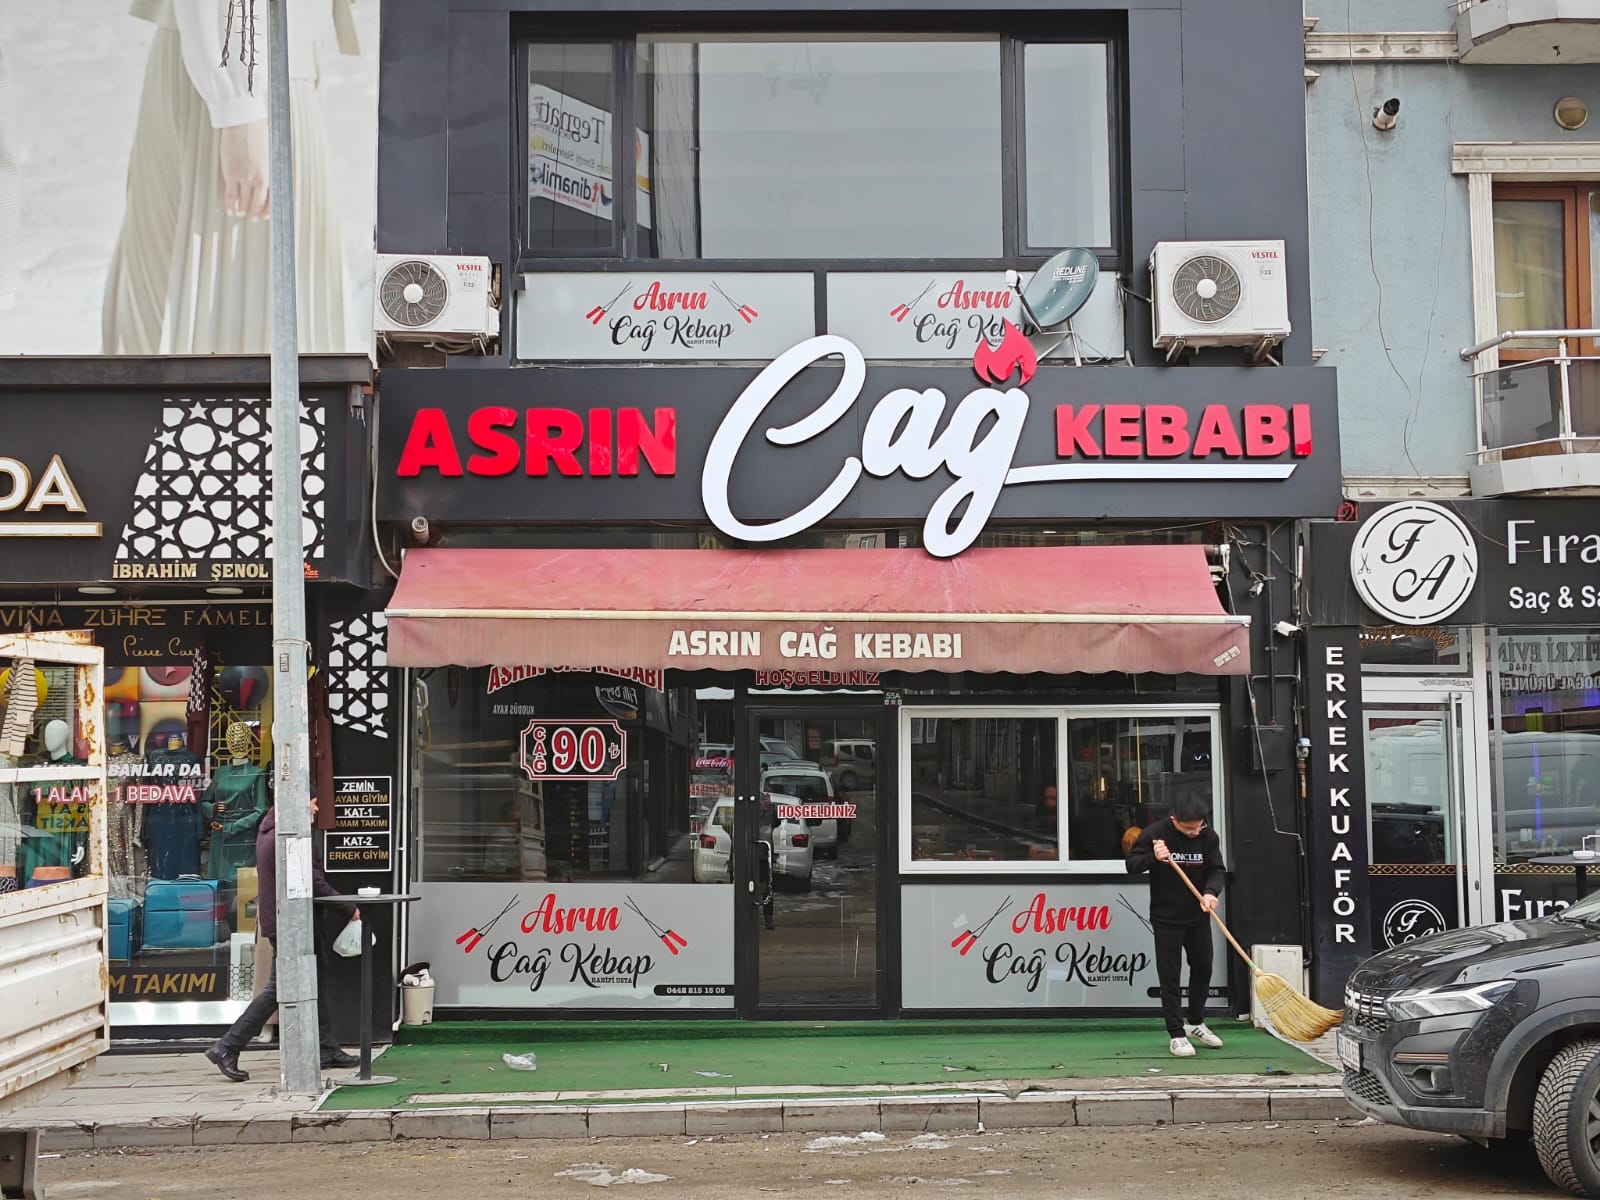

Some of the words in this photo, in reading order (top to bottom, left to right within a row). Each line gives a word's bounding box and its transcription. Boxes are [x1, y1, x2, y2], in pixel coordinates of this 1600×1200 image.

[664, 315, 734, 348] Kebap
[396, 406, 677, 477] ASRIN
[1056, 403, 1313, 458] KEBABI
[112, 560, 197, 578] İBRAHİM
[211, 563, 269, 581] ŞENOL
[1509, 586, 1551, 614] Saç
[1557, 585, 1574, 608] &
[1581, 585, 1600, 608] S
[183, 610, 273, 626] FAMEL
[668, 630, 761, 656] ASRIN
[780, 626, 837, 659] CAĞ
[854, 632, 962, 659] KEBABI
[1326, 647, 1349, 773] ERKEK
[552, 727, 606, 773] 90
[127, 785, 197, 803] BEDAVA
[342, 780, 374, 791] ZEMİN
[336, 794, 359, 803] AYAN
[336, 819, 358, 827] AMAM
[344, 808, 372, 816] KAT-1
[343, 836, 372, 846] KAT-2
[329, 851, 360, 860] ERKEK
[363, 849, 389, 860] GİYİM
[1330, 788, 1356, 943] KUAFÖR
[560, 942, 655, 988] Kebap
[1055, 942, 1151, 987] Kebap
[132, 972, 217, 994] TAKIMI
